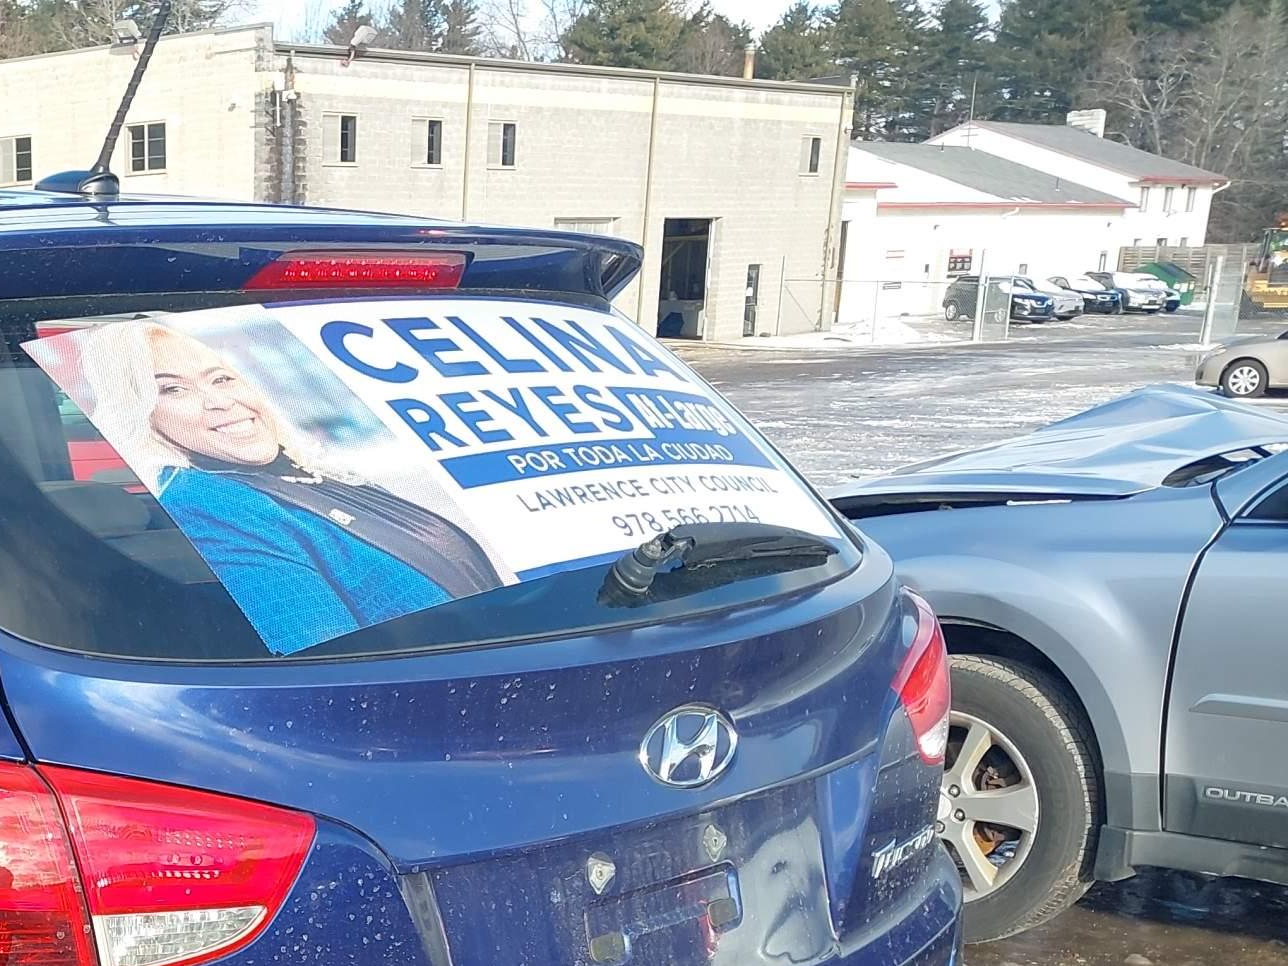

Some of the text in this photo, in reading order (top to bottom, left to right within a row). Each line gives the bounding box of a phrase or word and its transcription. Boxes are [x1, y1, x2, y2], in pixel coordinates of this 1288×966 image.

[320, 316, 690, 384] CELINA
[386, 384, 635, 452] REYES
[625, 394, 737, 436] At-Large
[507, 442, 734, 475] POR TODA LA CIUDAD
[516, 475, 779, 513] LAWRENCE CITY COUNCIL
